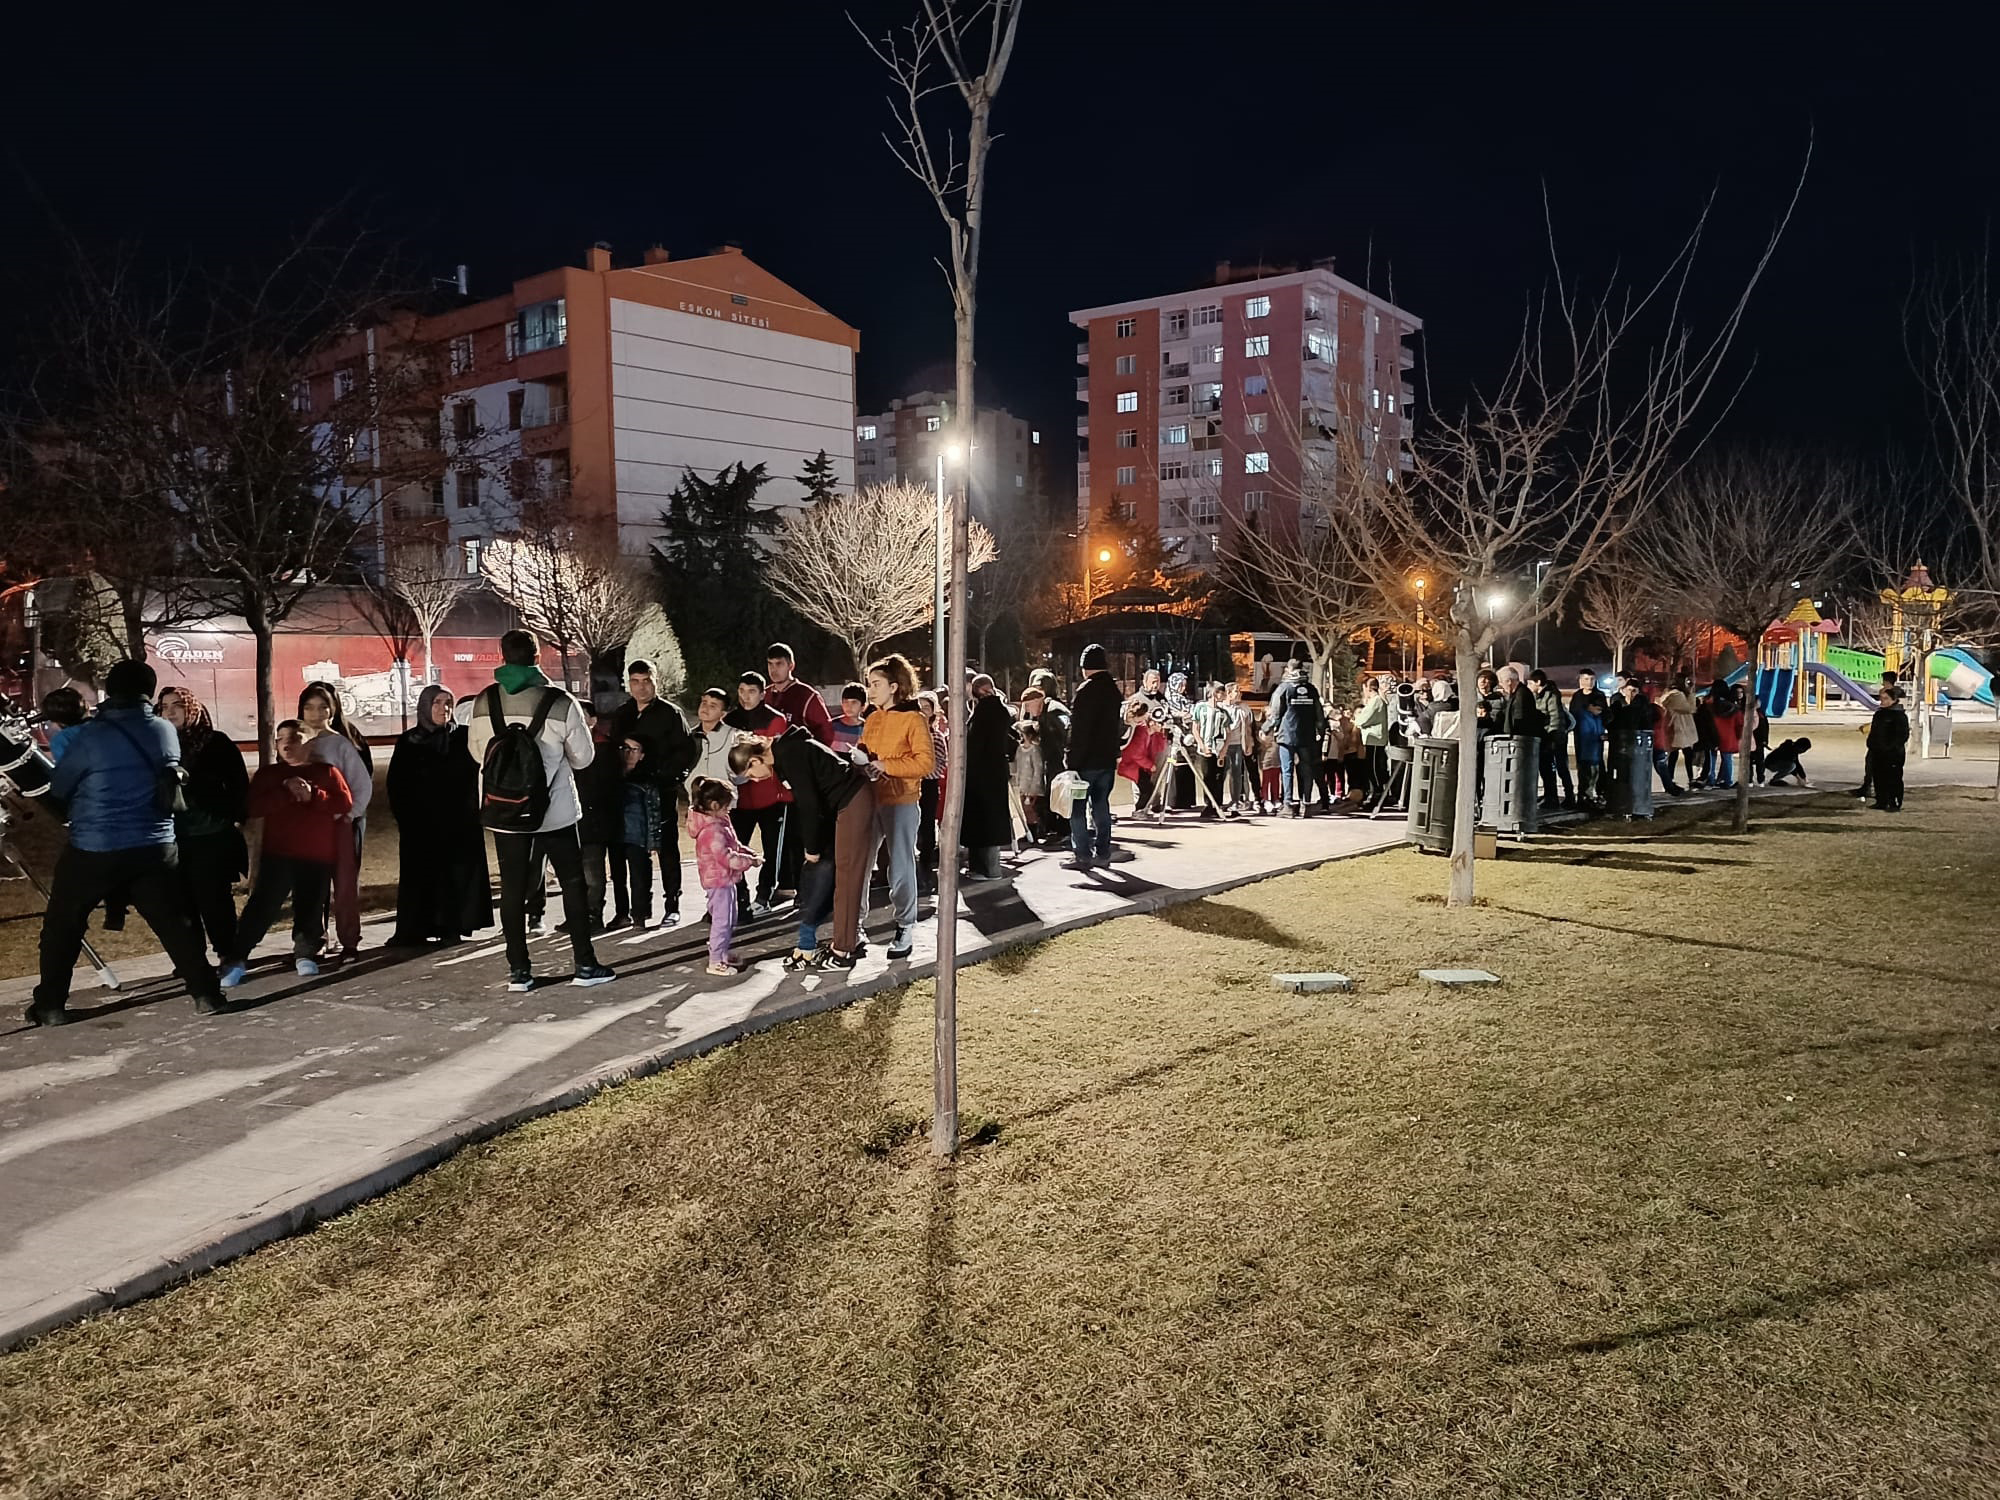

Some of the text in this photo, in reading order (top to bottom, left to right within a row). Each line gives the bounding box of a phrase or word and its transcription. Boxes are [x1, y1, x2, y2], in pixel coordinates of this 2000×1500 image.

[679, 301, 769, 328] ESKON SİTESİ
[172, 649, 224, 659] VADEN
